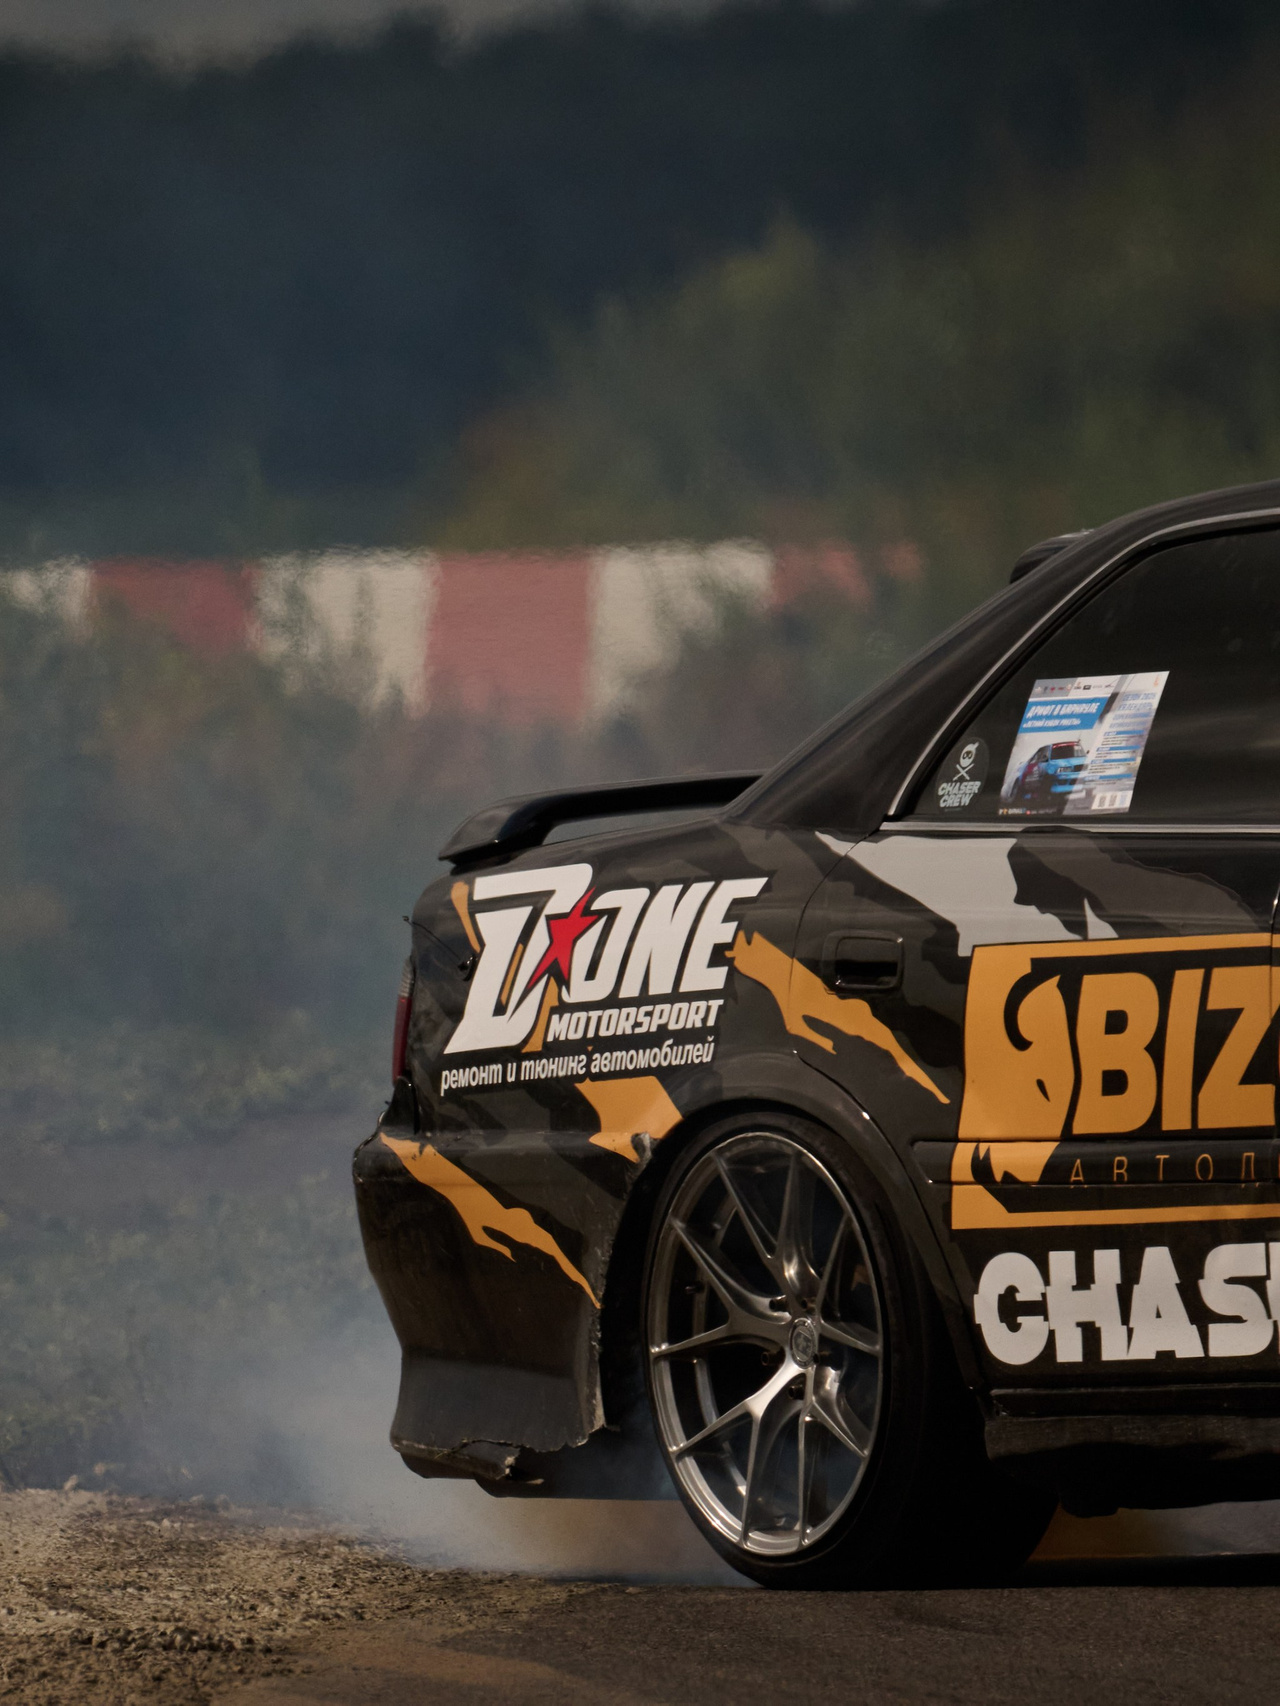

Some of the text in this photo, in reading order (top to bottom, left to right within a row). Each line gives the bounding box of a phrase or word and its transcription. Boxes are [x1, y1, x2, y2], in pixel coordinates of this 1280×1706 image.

[937, 781, 981, 796] CHASER
[939, 793, 974, 808] CREW
[546, 999, 724, 1042] MOTORSPORT
[441, 1036, 716, 1097] ремонт и тюнинг автомобилей
[1072, 964, 1280, 1135] BIZ
[973, 1241, 1280, 1366] CHAS
